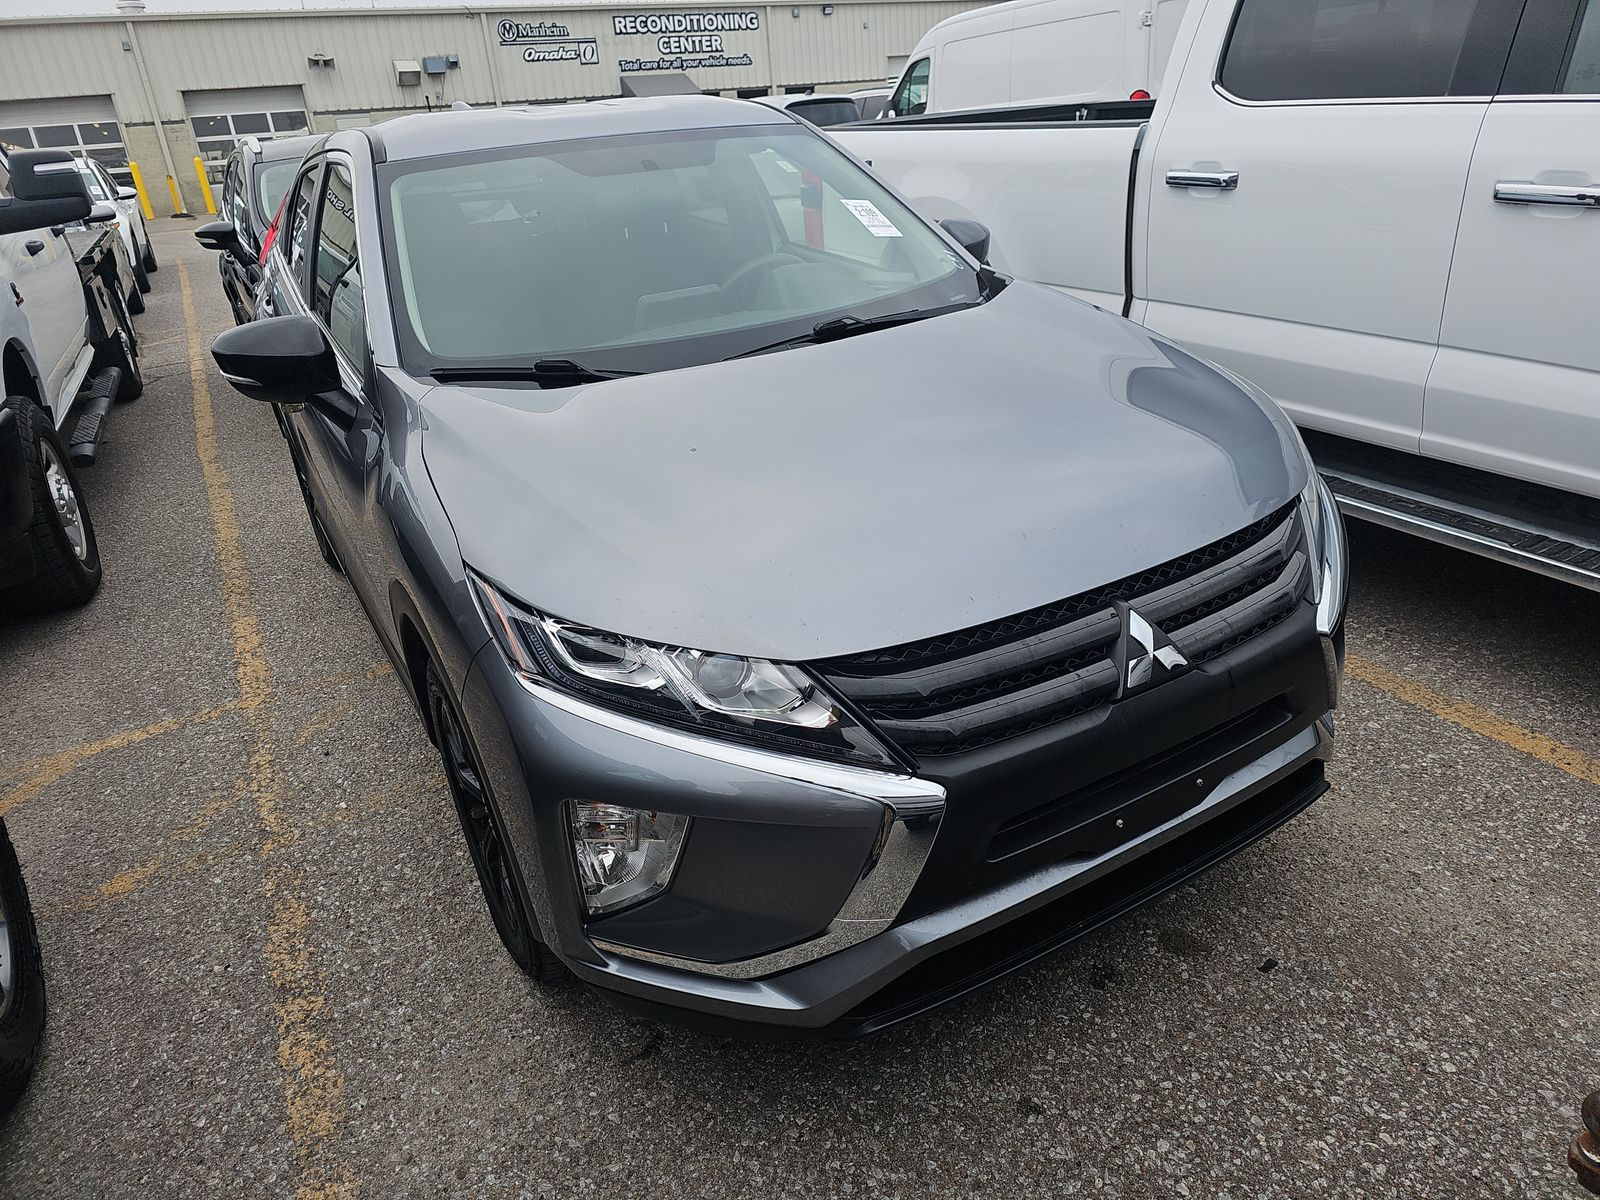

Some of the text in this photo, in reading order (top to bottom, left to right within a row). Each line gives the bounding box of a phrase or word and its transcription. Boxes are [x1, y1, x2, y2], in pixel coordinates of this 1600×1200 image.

[517, 22, 569, 37] Manheim
[613, 12, 759, 34] RECONDITIONING
[658, 35, 724, 54] CENTER
[523, 47, 579, 62] Omaha
[619, 59, 640, 71] Total
[640, 61, 658, 70] care
[659, 58, 671, 69] for
[671, 57, 682, 69] all
[682, 59, 700, 70] your
[700, 55, 727, 67] vehicle
